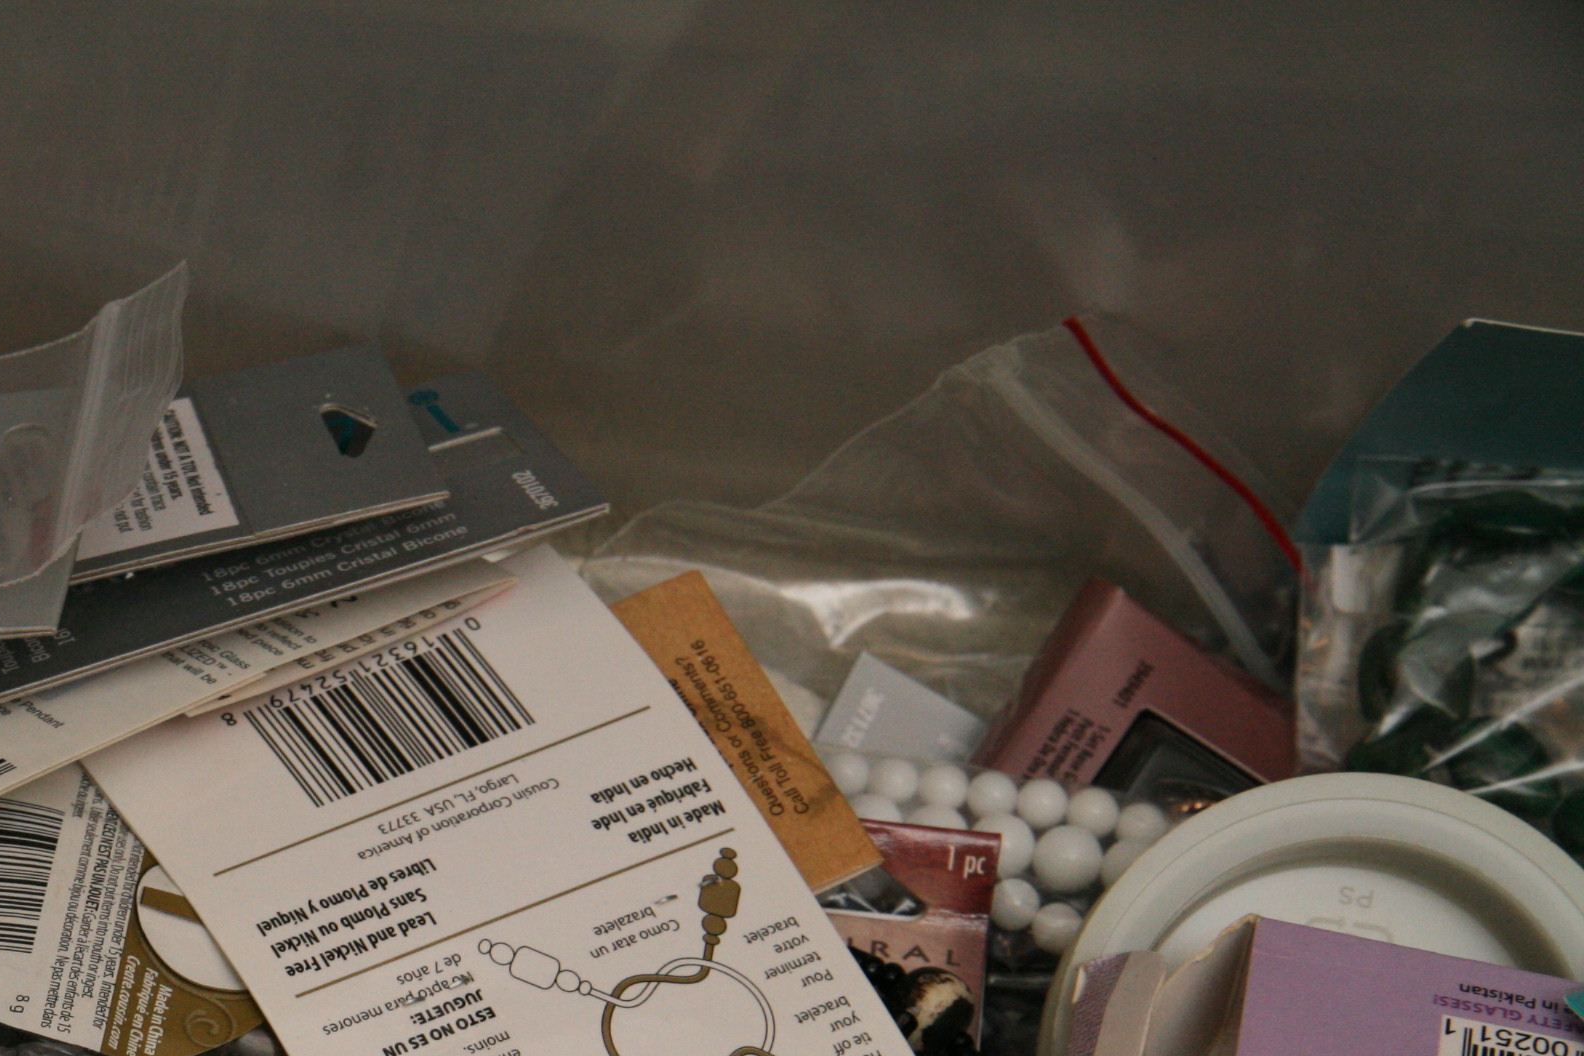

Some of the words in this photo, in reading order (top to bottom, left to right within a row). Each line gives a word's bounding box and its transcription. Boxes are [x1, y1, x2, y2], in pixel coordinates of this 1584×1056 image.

[172, 438, 190, 457] NOT
[177, 452, 191, 462] A
[208, 571, 260, 599] 18pc
[262, 546, 338, 582] Toupies
[341, 525, 401, 556] Cristal
[404, 508, 457, 536] 6mm
[226, 583, 277, 612] 18pc
[278, 564, 333, 593] 6mm
[335, 542, 400, 575] Cristal
[403, 522, 468, 554] Bicone
[218, 646, 251, 674] Glass
[200, 671, 217, 686] be
[675, 655, 732, 732] Comments?
[19, 697, 64, 732] Pendant
[726, 732, 742, 749] or
[750, 729, 776, 759] Free
[629, 773, 649, 790] en
[649, 755, 696, 785] Hecho
[737, 749, 784, 816] Questions
[767, 761, 791, 786] Toll
[512, 775, 560, 803] Cousin
[589, 781, 630, 808] India
[783, 787, 810, 815] Call
[422, 796, 455, 818] USA
[429, 792, 513, 834] Corporation
[624, 801, 645, 818] en
[681, 798, 725, 826] Made
[376, 810, 419, 836] 33773
[413, 825, 429, 840] of
[590, 810, 623, 835] Inde
[626, 820, 668, 847] India
[666, 814, 684, 832] in
[356, 831, 414, 863] America
[387, 856, 437, 887] Libres
[946, 844, 955, 870] 1
[963, 854, 985, 880] pc
[318, 882, 367, 913] Plomo
[366, 874, 389, 895] de
[388, 886, 427, 913] Sans
[317, 920, 339, 938] ou
[338, 900, 390, 932] Plomb
[396, 908, 437, 937] Lead
[591, 903, 656, 939] brazalete
[638, 916, 680, 943] Como
[269, 928, 319, 958] Nickel
[367, 924, 398, 949] and
[742, 915, 798, 946] bracelet
[772, 932, 810, 956] votre
[107, 945, 121, 956] 15
[319, 936, 368, 967] Nickel
[442, 951, 464, 971] de
[283, 955, 320, 981] Free
[762, 950, 822, 982] terminer
[799, 967, 833, 989] Pour
[15, 993, 30, 1002] 8
[107, 954, 140, 1049] Create.cousin.com
[134, 966, 159, 1015] Fabriqué
[153, 983, 173, 1015] Made
[1458, 982, 1535, 1009] Pakistan
[9, 1004, 24, 1014] g
[58, 1010, 71, 1022] de
[451, 1004, 496, 1032] ESTO
[792, 994, 849, 1025] bracelet
[1431, 993, 1523, 1022] GLASSES!
[1540, 999, 1558, 1012] in
[55, 1022, 71, 1034] 15
[131, 1013, 145, 1028] en
[150, 1014, 166, 1025] in
[321, 1003, 385, 1039] menores
[427, 1021, 453, 1042] NO
[826, 1009, 860, 1033] your
[1443, 1017, 1458, 1036] 1
[143, 1024, 164, 1056] China
[407, 1032, 428, 1050] ES
[831, 1038, 852, 1056] off
